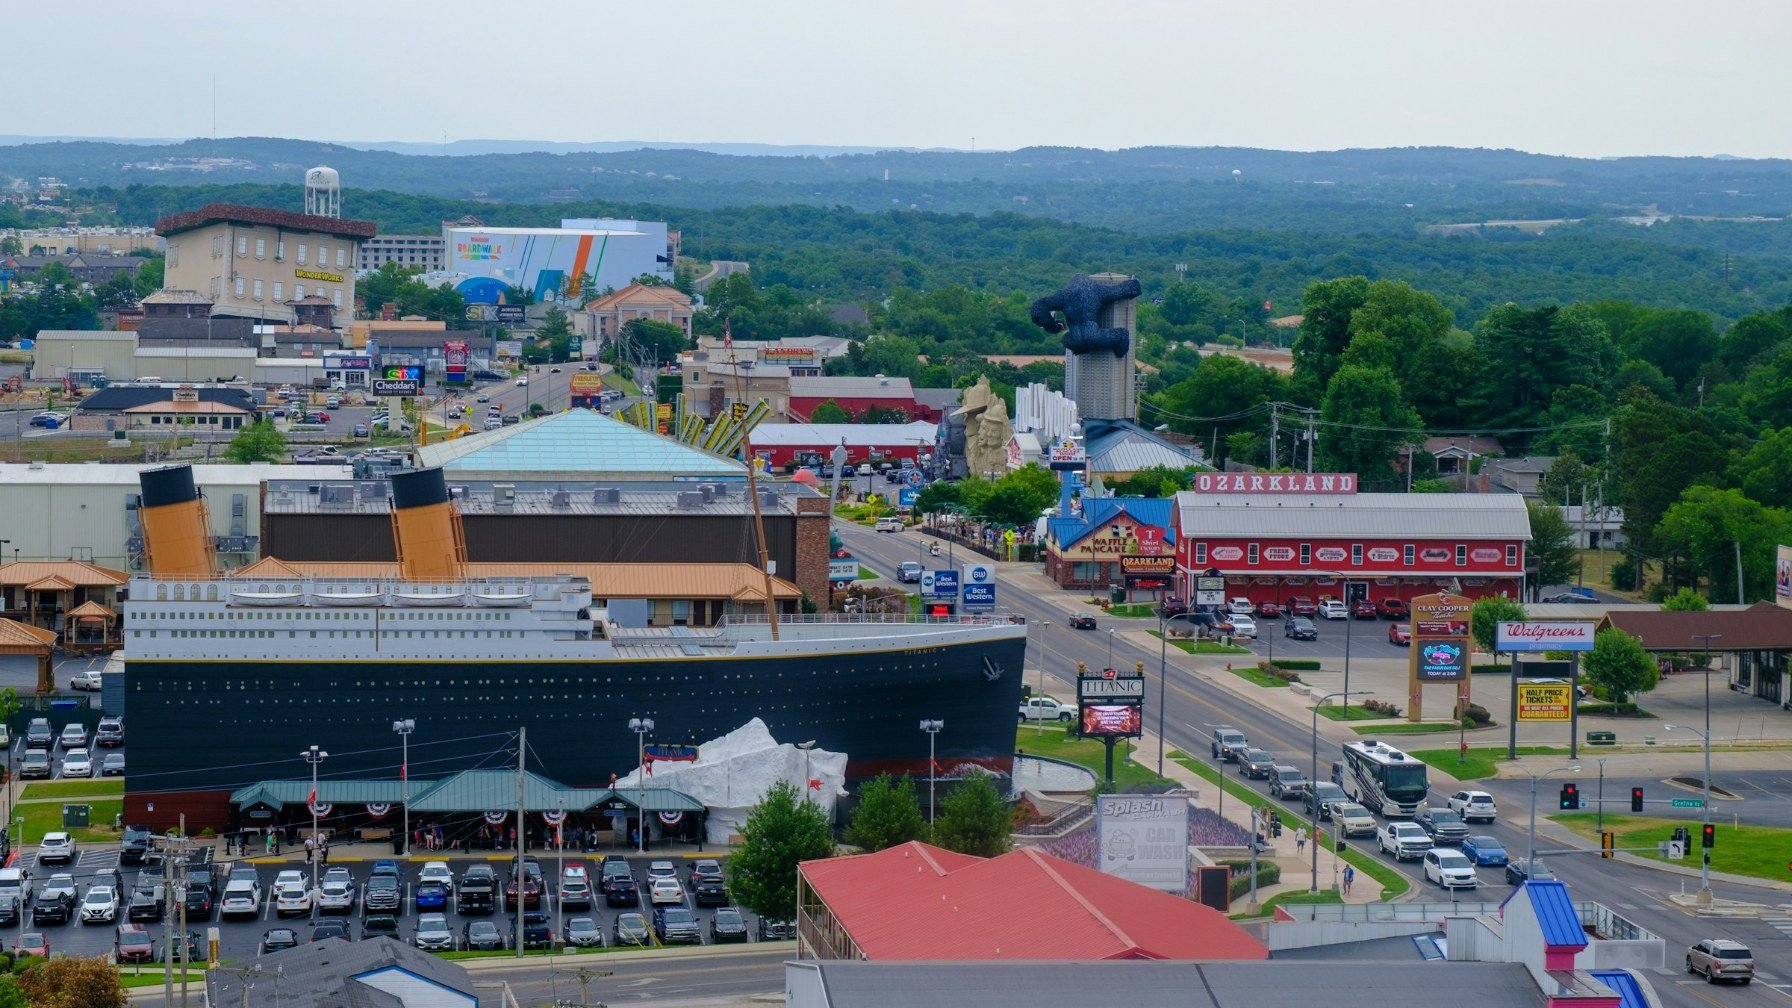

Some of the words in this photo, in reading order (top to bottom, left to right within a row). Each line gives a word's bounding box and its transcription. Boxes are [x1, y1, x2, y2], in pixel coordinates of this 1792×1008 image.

[458, 244, 501, 254] BOARDWALK
[376, 382, 414, 390] Cheddar's
[1200, 475, 1352, 491] OZARKLAND
[1146, 530, 1155, 539] T
[1122, 558, 1174, 567] OZARKLAND
[1506, 623, 1585, 641] Walgreens
[1084, 680, 1140, 692] TITANIC
[1103, 800, 1162, 817] Splash
[1145, 828, 1176, 842] CAR
[1138, 845, 1184, 859] WASH
